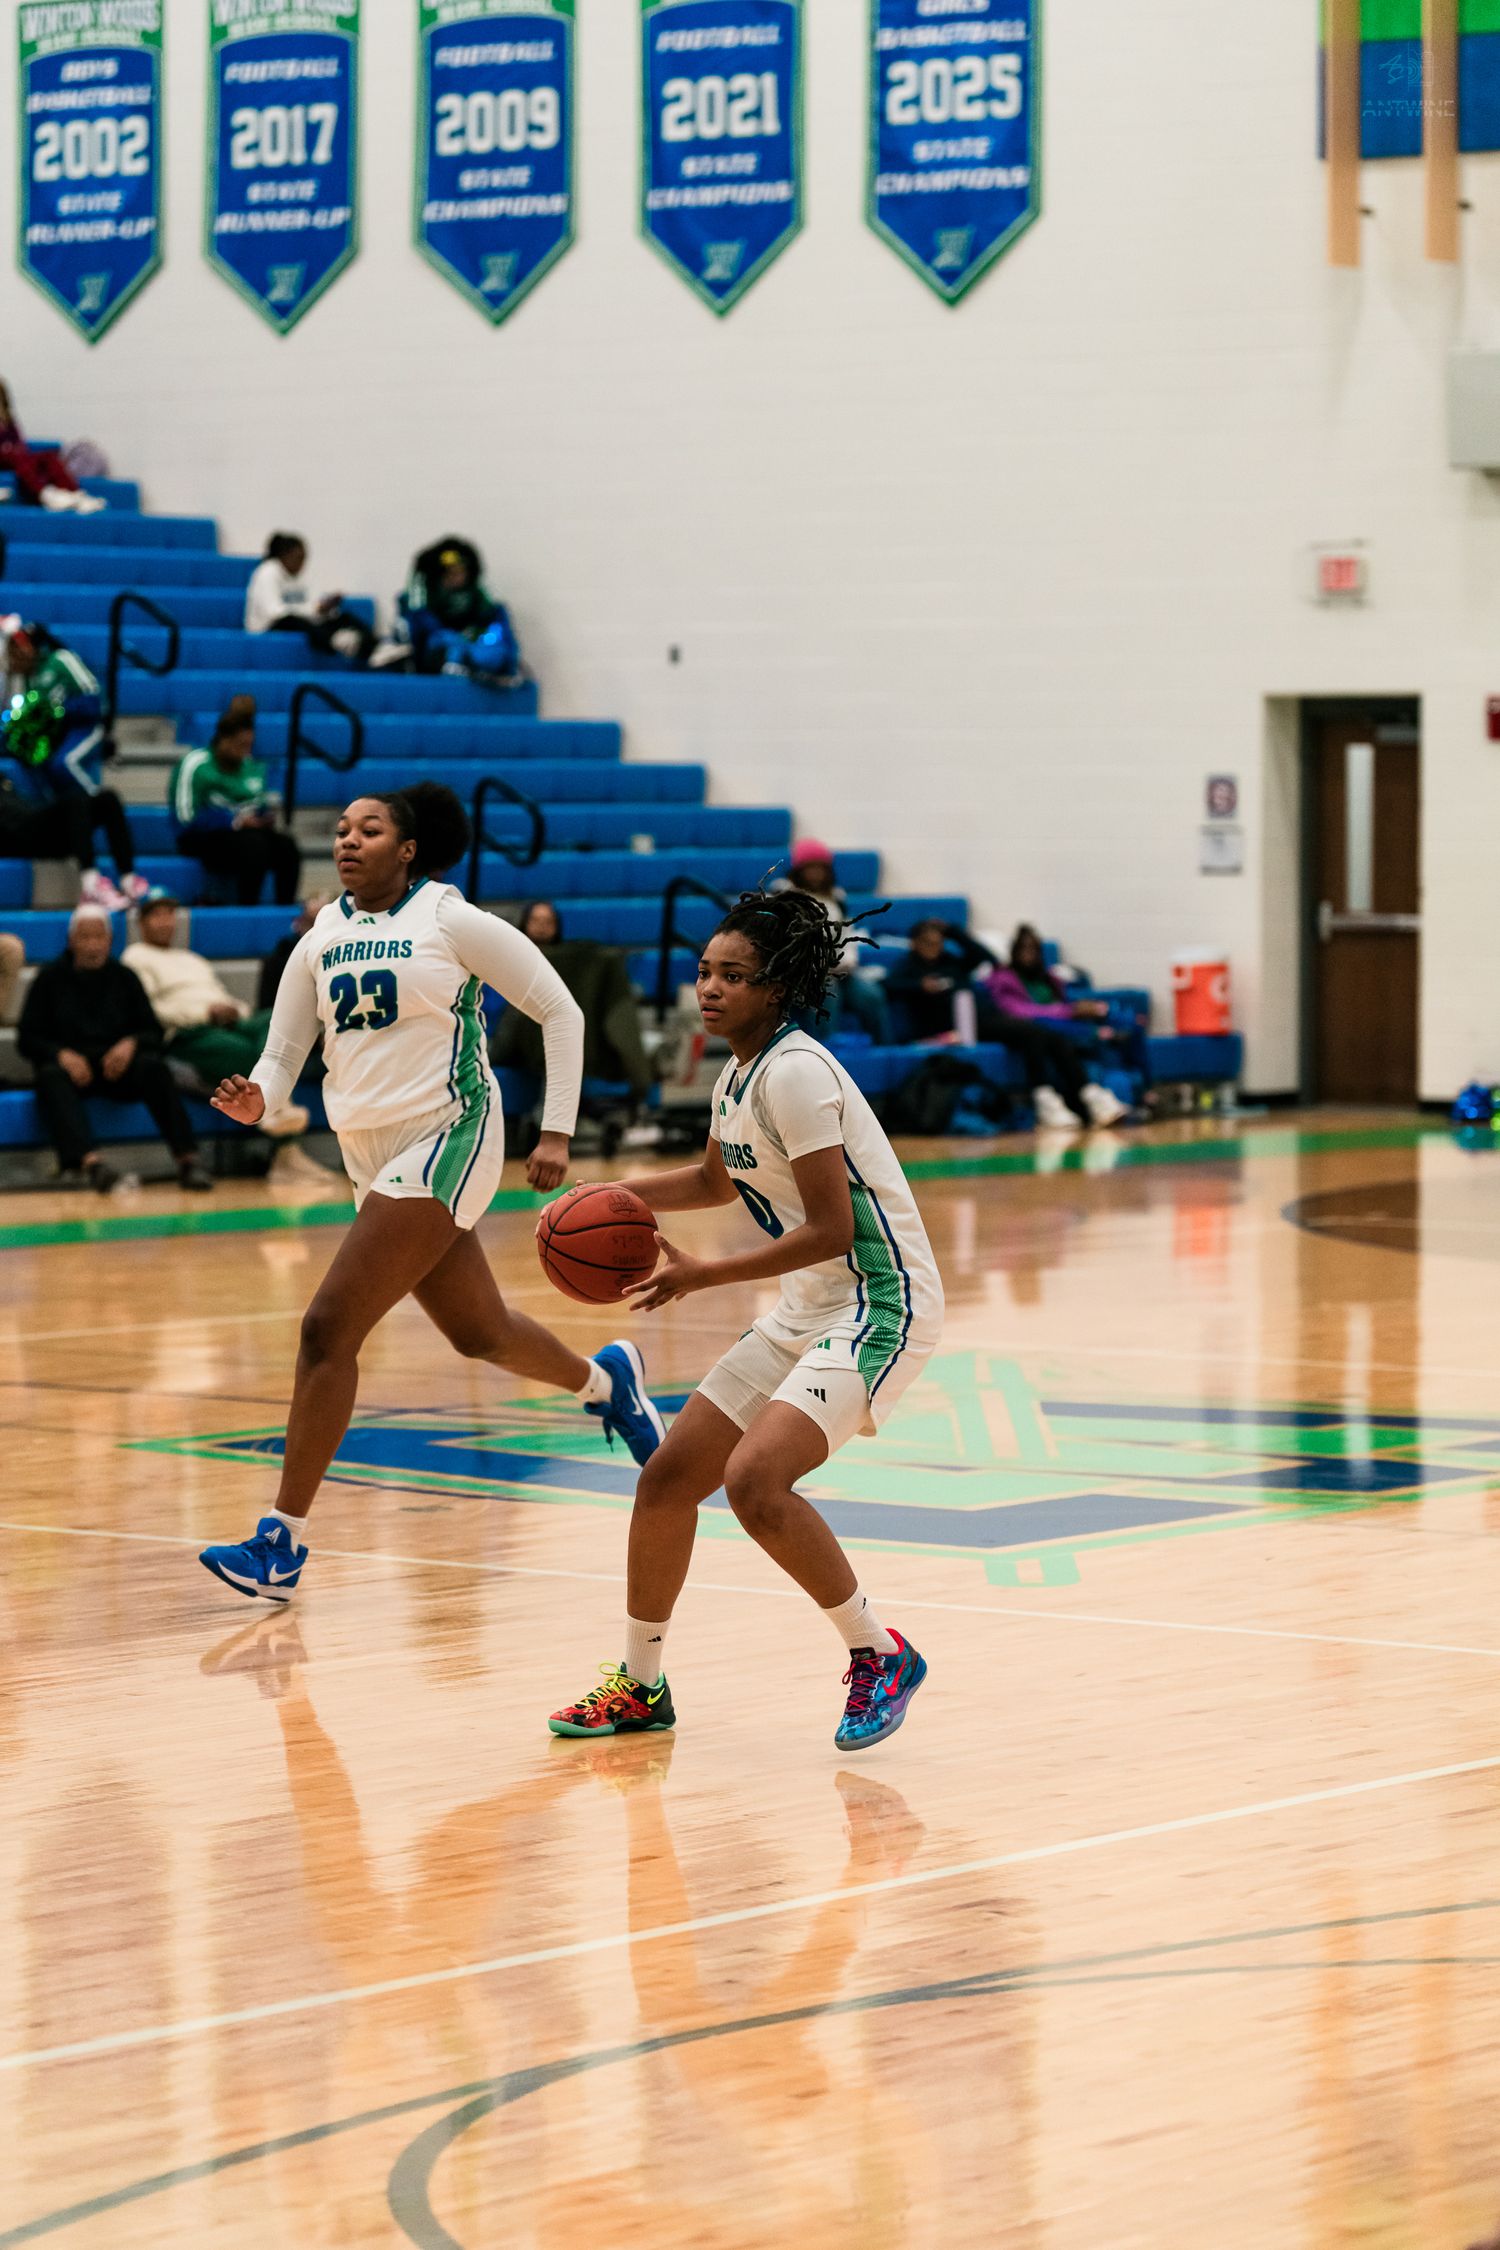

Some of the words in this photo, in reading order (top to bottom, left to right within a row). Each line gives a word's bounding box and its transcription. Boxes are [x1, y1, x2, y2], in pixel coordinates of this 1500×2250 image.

[435, 87, 560, 156] 2009
[660, 71, 781, 142] 2021
[886, 53, 1022, 126] 2025
[33, 115, 149, 182] 2002
[230, 102, 338, 169] 2017
[322, 940, 412, 971] WARRIORS
[330, 969, 398, 1034] 23
